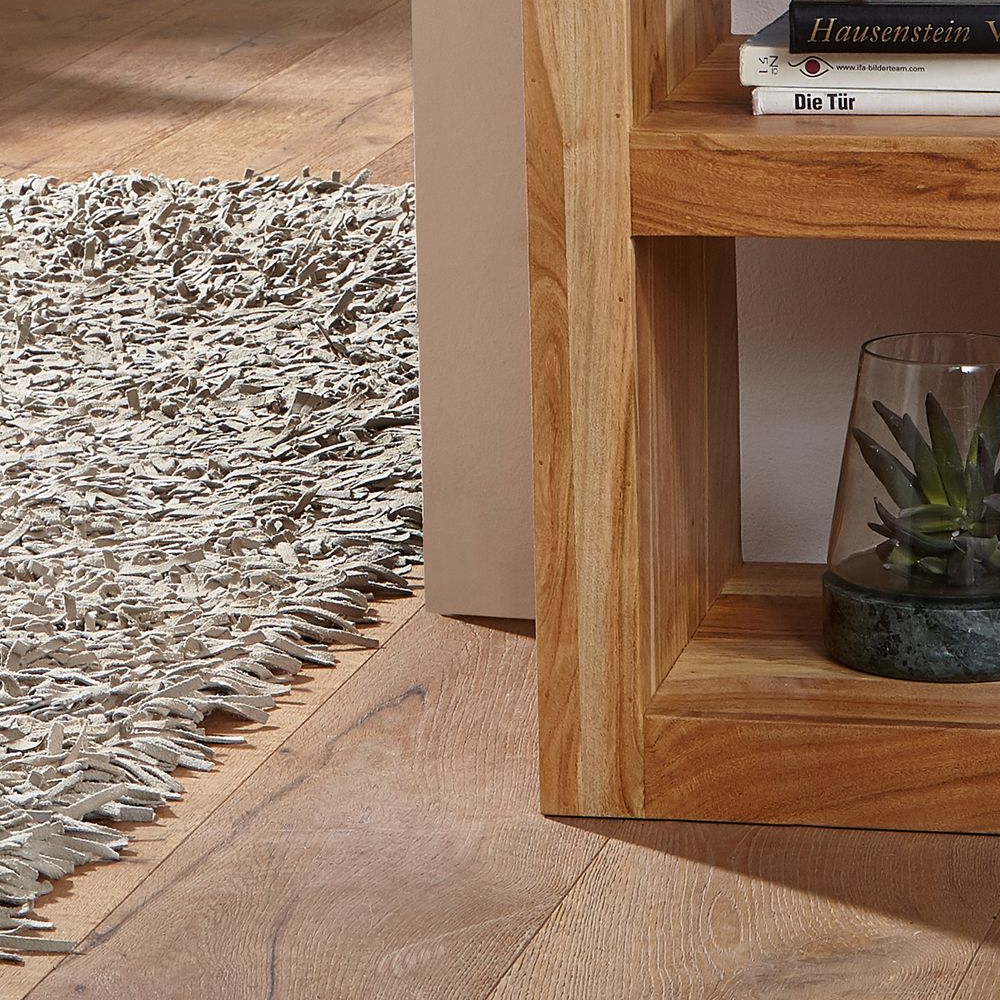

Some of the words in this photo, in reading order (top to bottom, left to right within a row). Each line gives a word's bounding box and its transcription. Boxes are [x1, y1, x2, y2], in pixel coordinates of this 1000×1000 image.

[807, 17, 971, 43] Hausenstein
[836, 64, 925, 73] www.ifa-bilderteam.com
[794, 93, 823, 110] Die
[827, 92, 856, 110] Tür
